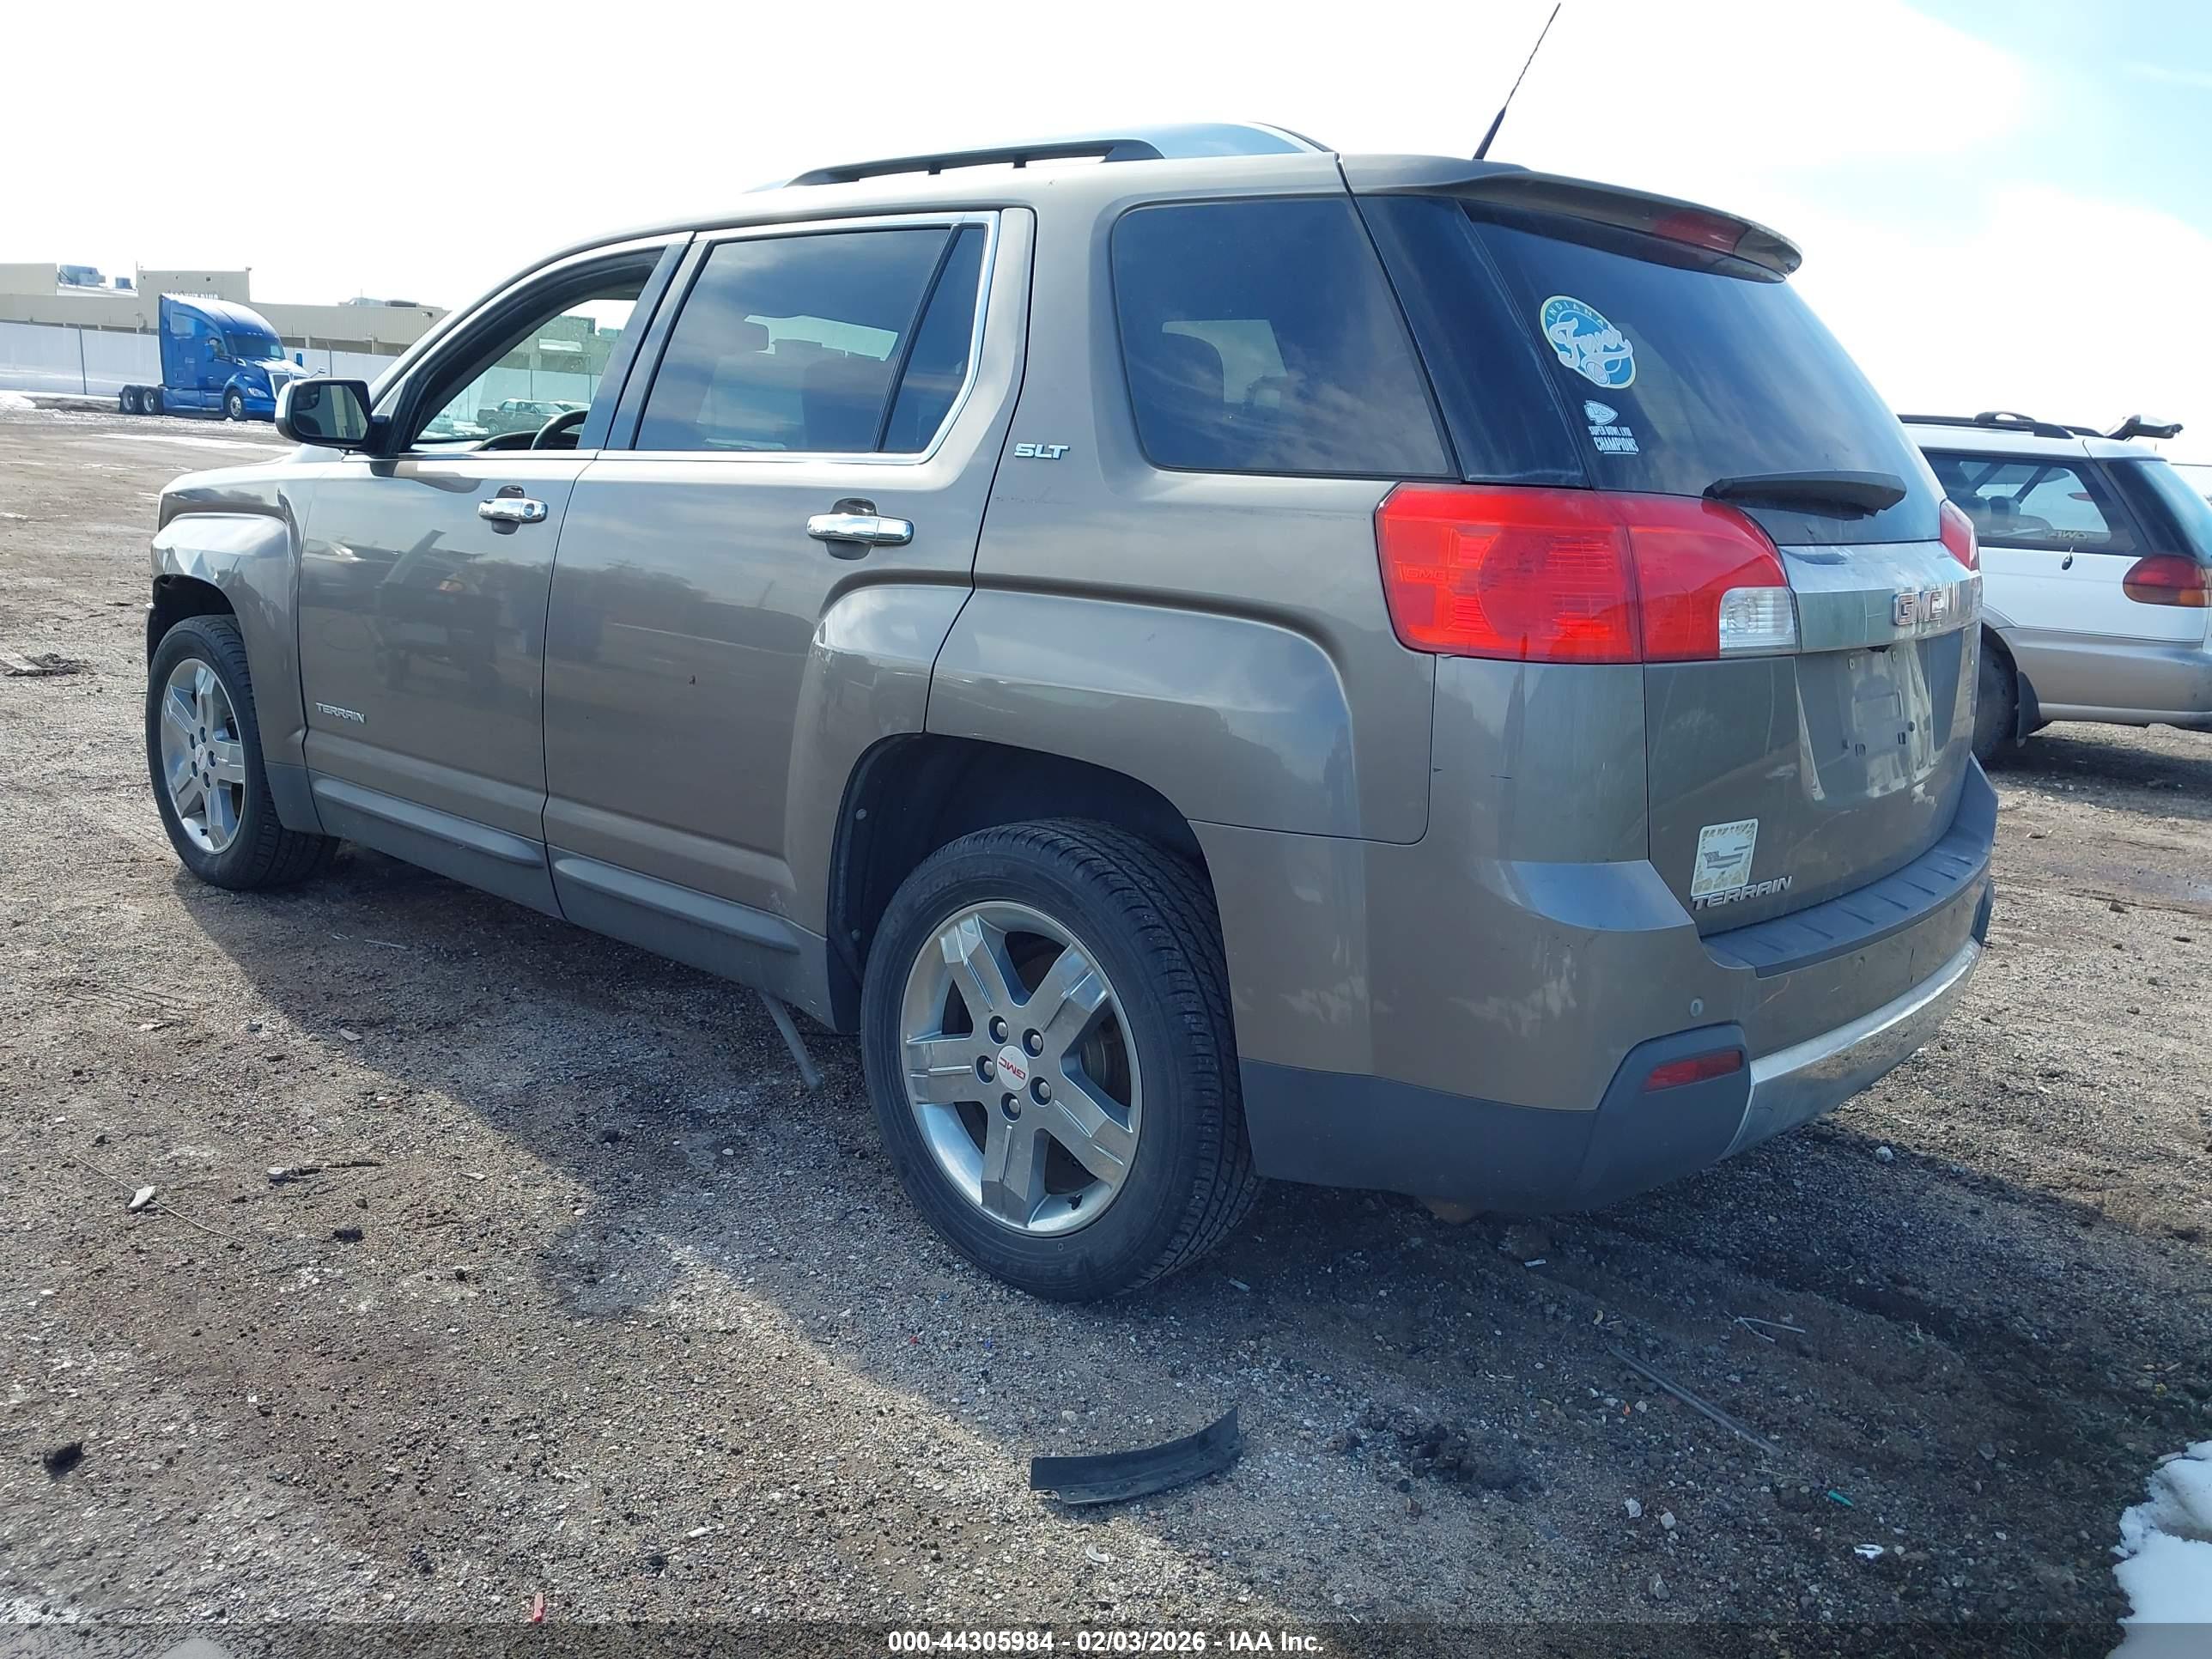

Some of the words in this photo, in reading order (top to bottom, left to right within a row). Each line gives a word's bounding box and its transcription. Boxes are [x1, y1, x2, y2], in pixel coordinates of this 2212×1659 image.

[1547, 301, 1605, 326] INDIANA
[1588, 425, 1608, 436] SUPER
[1603, 426, 1622, 436] BOWL
[1014, 442, 1070, 460] SLT
[1593, 436, 1640, 453] CHAMPIONS
[1407, 568, 1445, 581] GMC
[1893, 589, 1943, 625] GMC
[315, 701, 365, 724] TERRAIN
[1691, 876, 1793, 910] TERRAIN
[998, 1056, 1026, 1080] GMC
